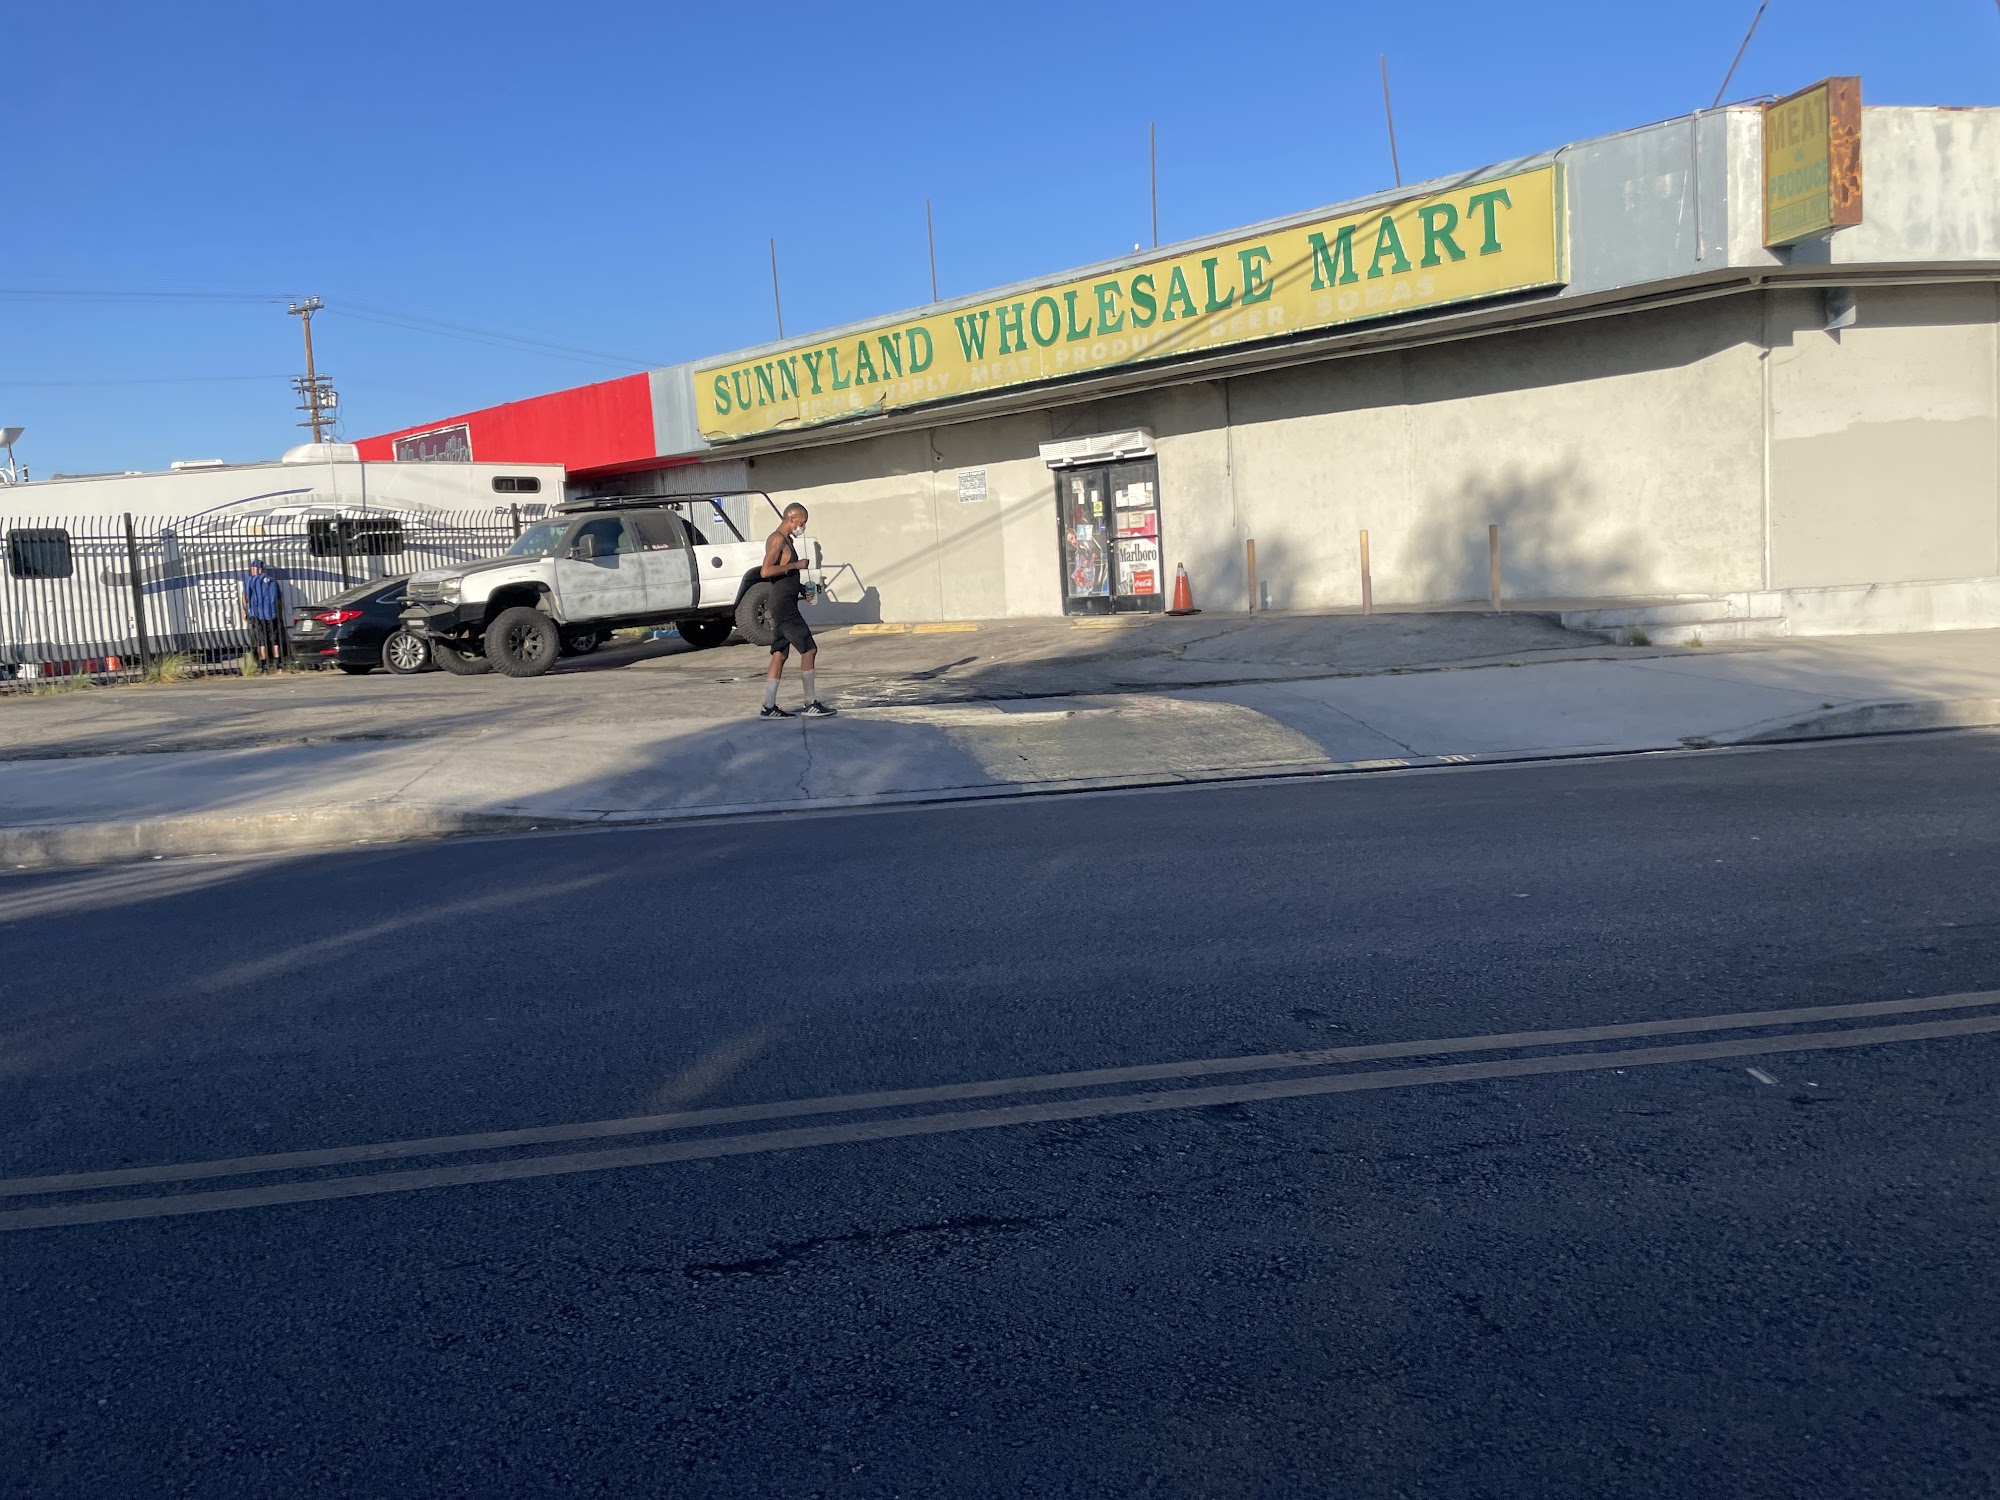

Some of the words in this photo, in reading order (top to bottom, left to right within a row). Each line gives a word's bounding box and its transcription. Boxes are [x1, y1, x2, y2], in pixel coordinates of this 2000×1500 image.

[1768, 94, 1827, 152] MEAT
[1768, 155, 1829, 205] PRODUCE
[714, 325, 934, 417] SUNNYLAND
[953, 245, 1274, 363] WHOLESALE
[1307, 188, 1513, 292] MART
[1316, 273, 1436, 318] SODAS
[1119, 543, 1157, 562] Marlboro
